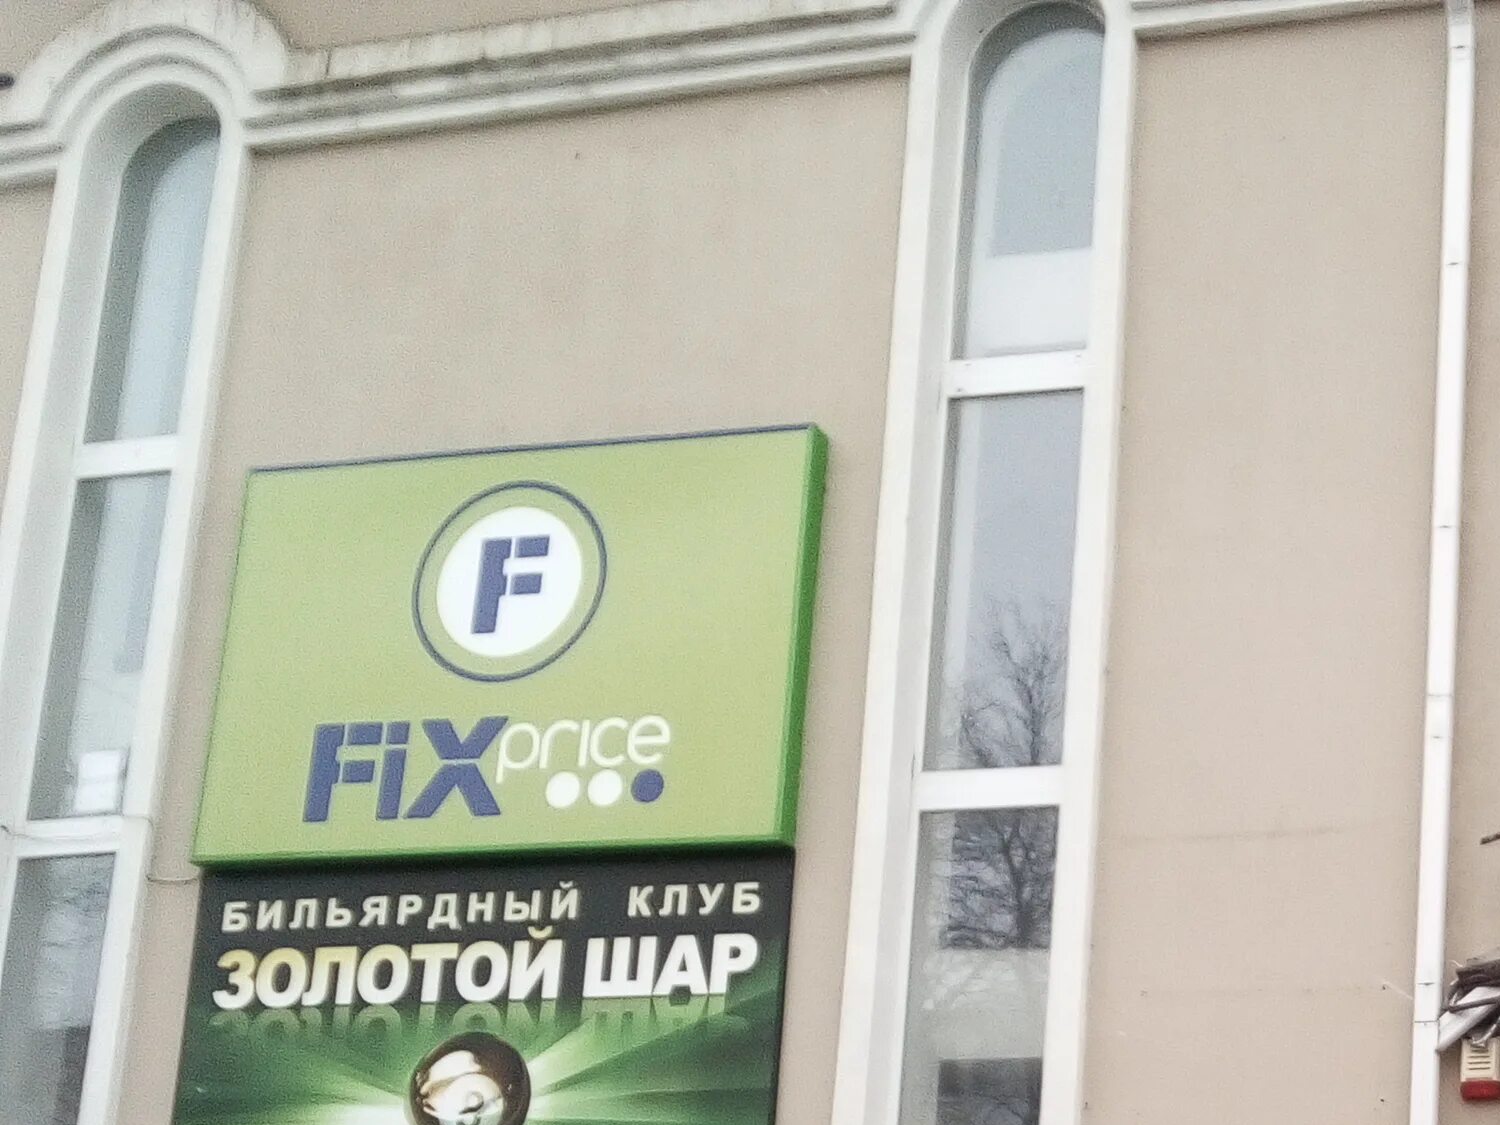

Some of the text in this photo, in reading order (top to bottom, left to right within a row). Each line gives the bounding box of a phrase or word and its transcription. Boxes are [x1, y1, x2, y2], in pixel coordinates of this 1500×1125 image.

[470, 534, 551, 635] F
[221, 880, 763, 933] БИЛЬЯРДНЫЙ КЛУБ
[212, 928, 758, 1010] ЗОЛОТОЙ ШАР
